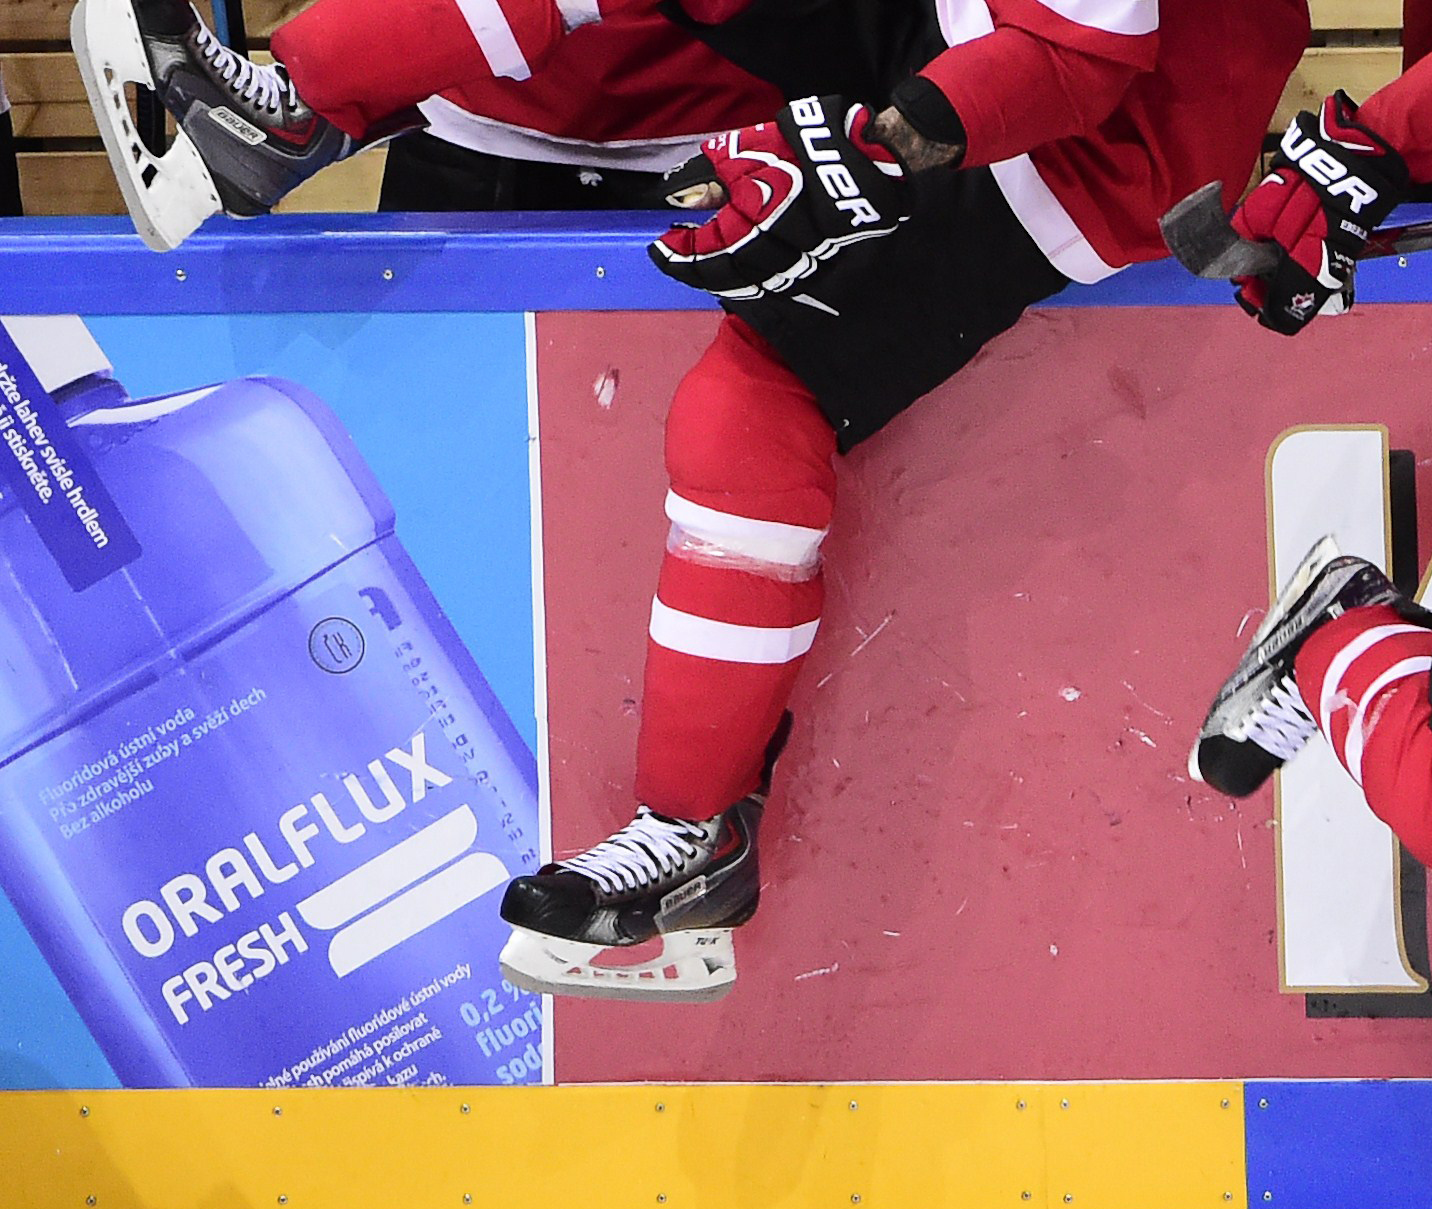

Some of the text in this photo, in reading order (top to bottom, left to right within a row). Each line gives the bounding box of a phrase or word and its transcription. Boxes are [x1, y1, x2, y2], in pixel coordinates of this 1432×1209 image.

[214, 108, 262, 144] BAUER
[2, 426, 54, 506] stiskněte.
[13, 398, 50, 448] lahev
[39, 442, 75, 492] svisle
[65, 485, 110, 550] hrdlem
[38, 706, 196, 807] Fluoridová ústní voda
[76, 757, 145, 809] zdravější
[141, 741, 181, 770] zuby
[181, 732, 193, 747] a
[190, 706, 230, 742] svěží
[228, 686, 268, 718] dech
[59, 777, 155, 841] Bez alkoholu
[121, 732, 454, 959] ORALFLUX
[159, 904, 313, 1026] FRESH
[459, 987, 505, 1028] 0,2
[290, 1033, 351, 1079] používání
[409, 980, 443, 1007] ústní
[440, 962, 472, 989] vody
[323, 1043, 375, 1084] pomáhá
[371, 1012, 429, 1056] posilovat
[383, 1026, 443, 1071] k ochraně
